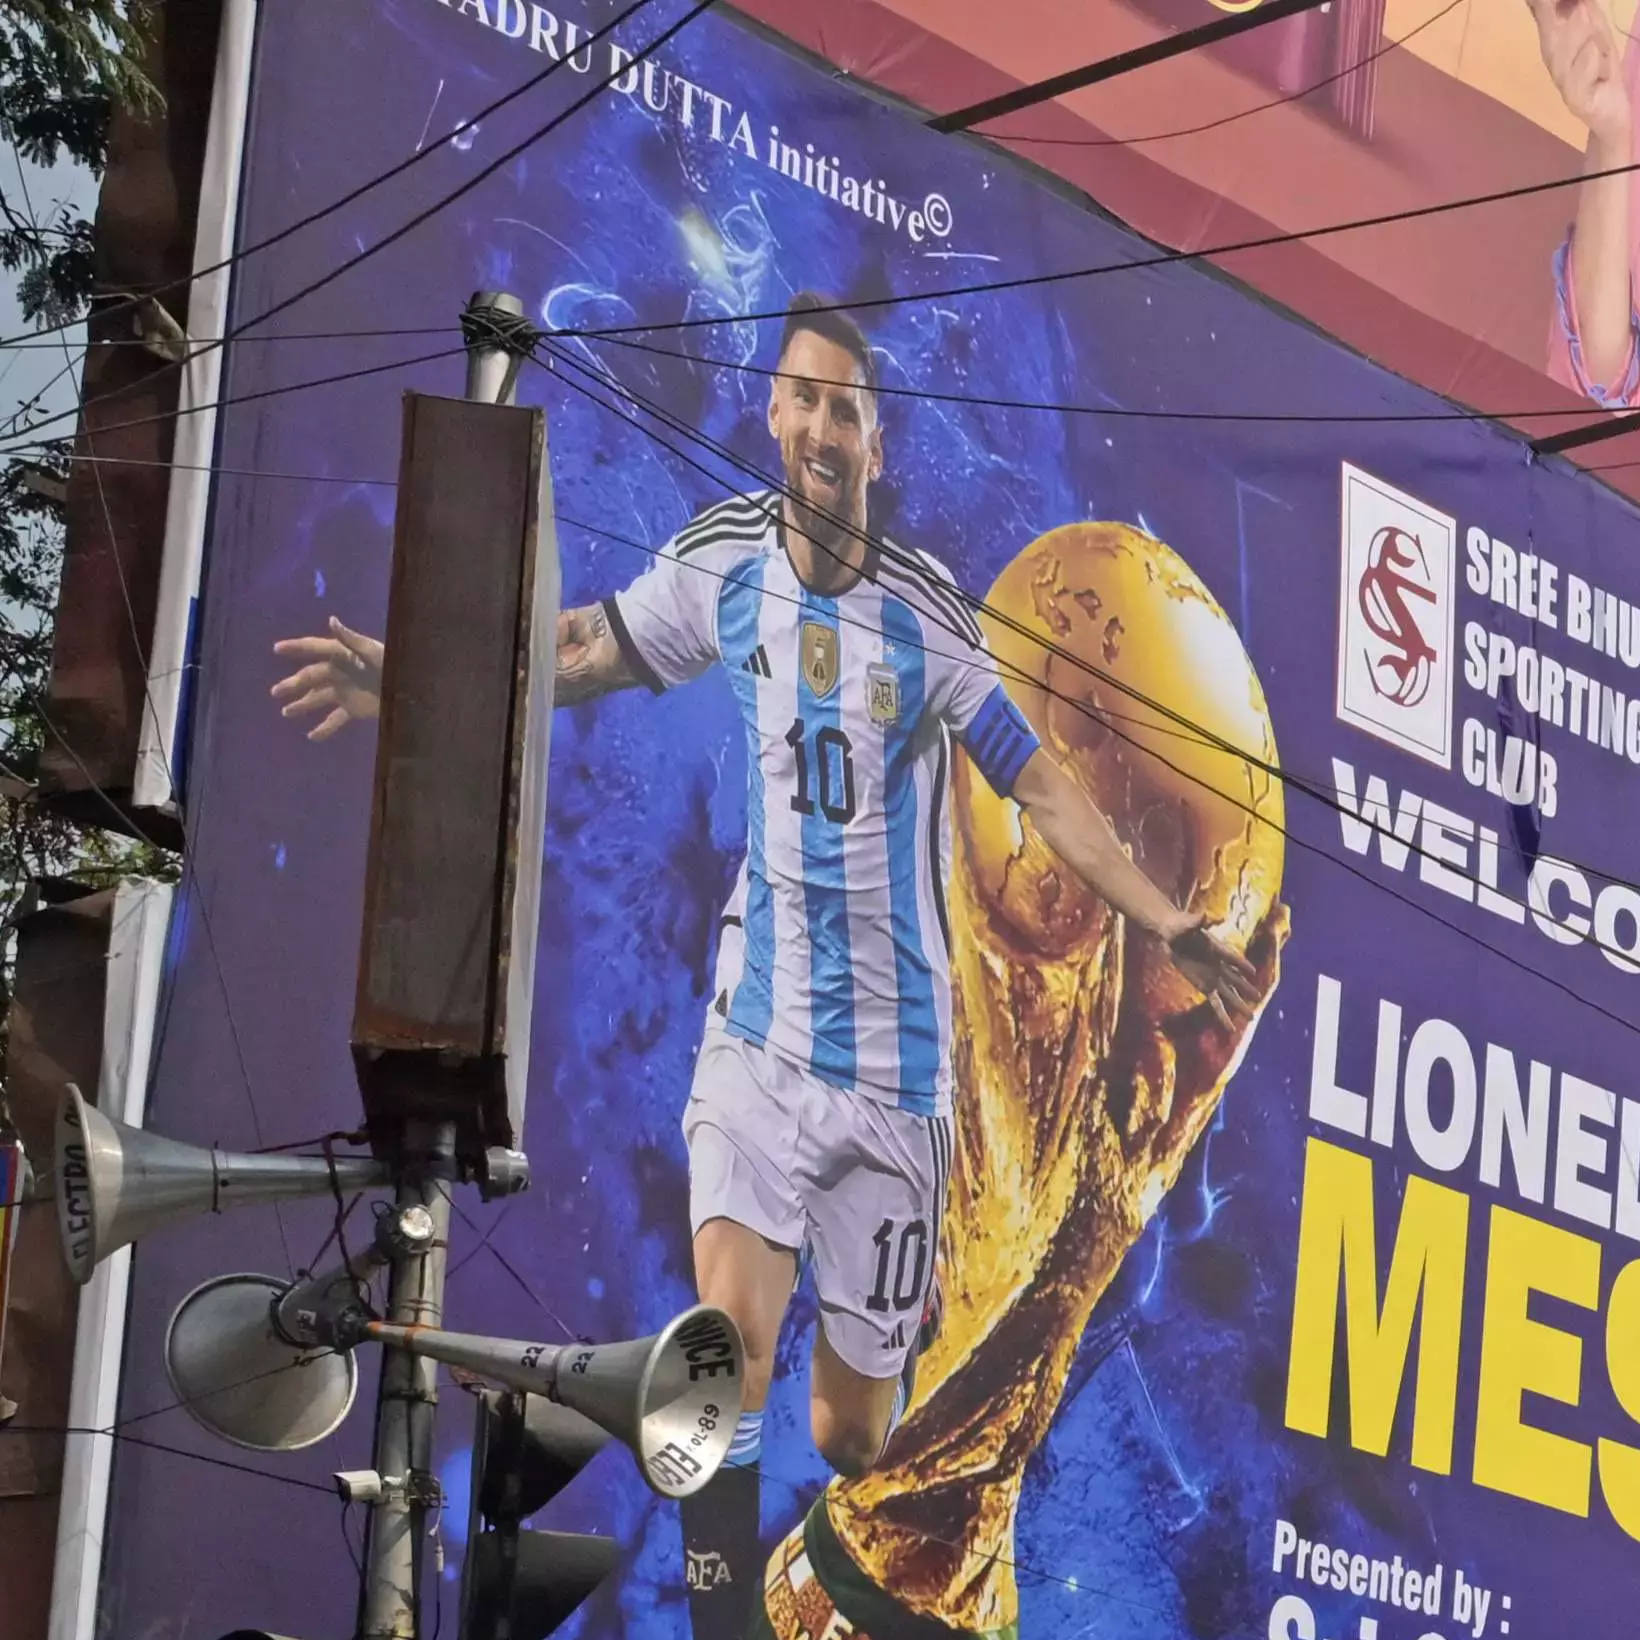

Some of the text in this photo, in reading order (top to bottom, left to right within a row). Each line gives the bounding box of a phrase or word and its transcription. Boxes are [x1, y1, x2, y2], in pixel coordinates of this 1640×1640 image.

[438, 0, 594, 73] ADRU
[608, 42, 758, 158] DUTTA
[1465, 526, 1559, 628] SREE
[784, 717, 856, 826] 10
[1462, 714, 1557, 818] CLUB
[866, 1217, 928, 1315] 10
[1273, 1520, 1442, 1617] Presented
[1451, 1566, 1490, 1640] by
